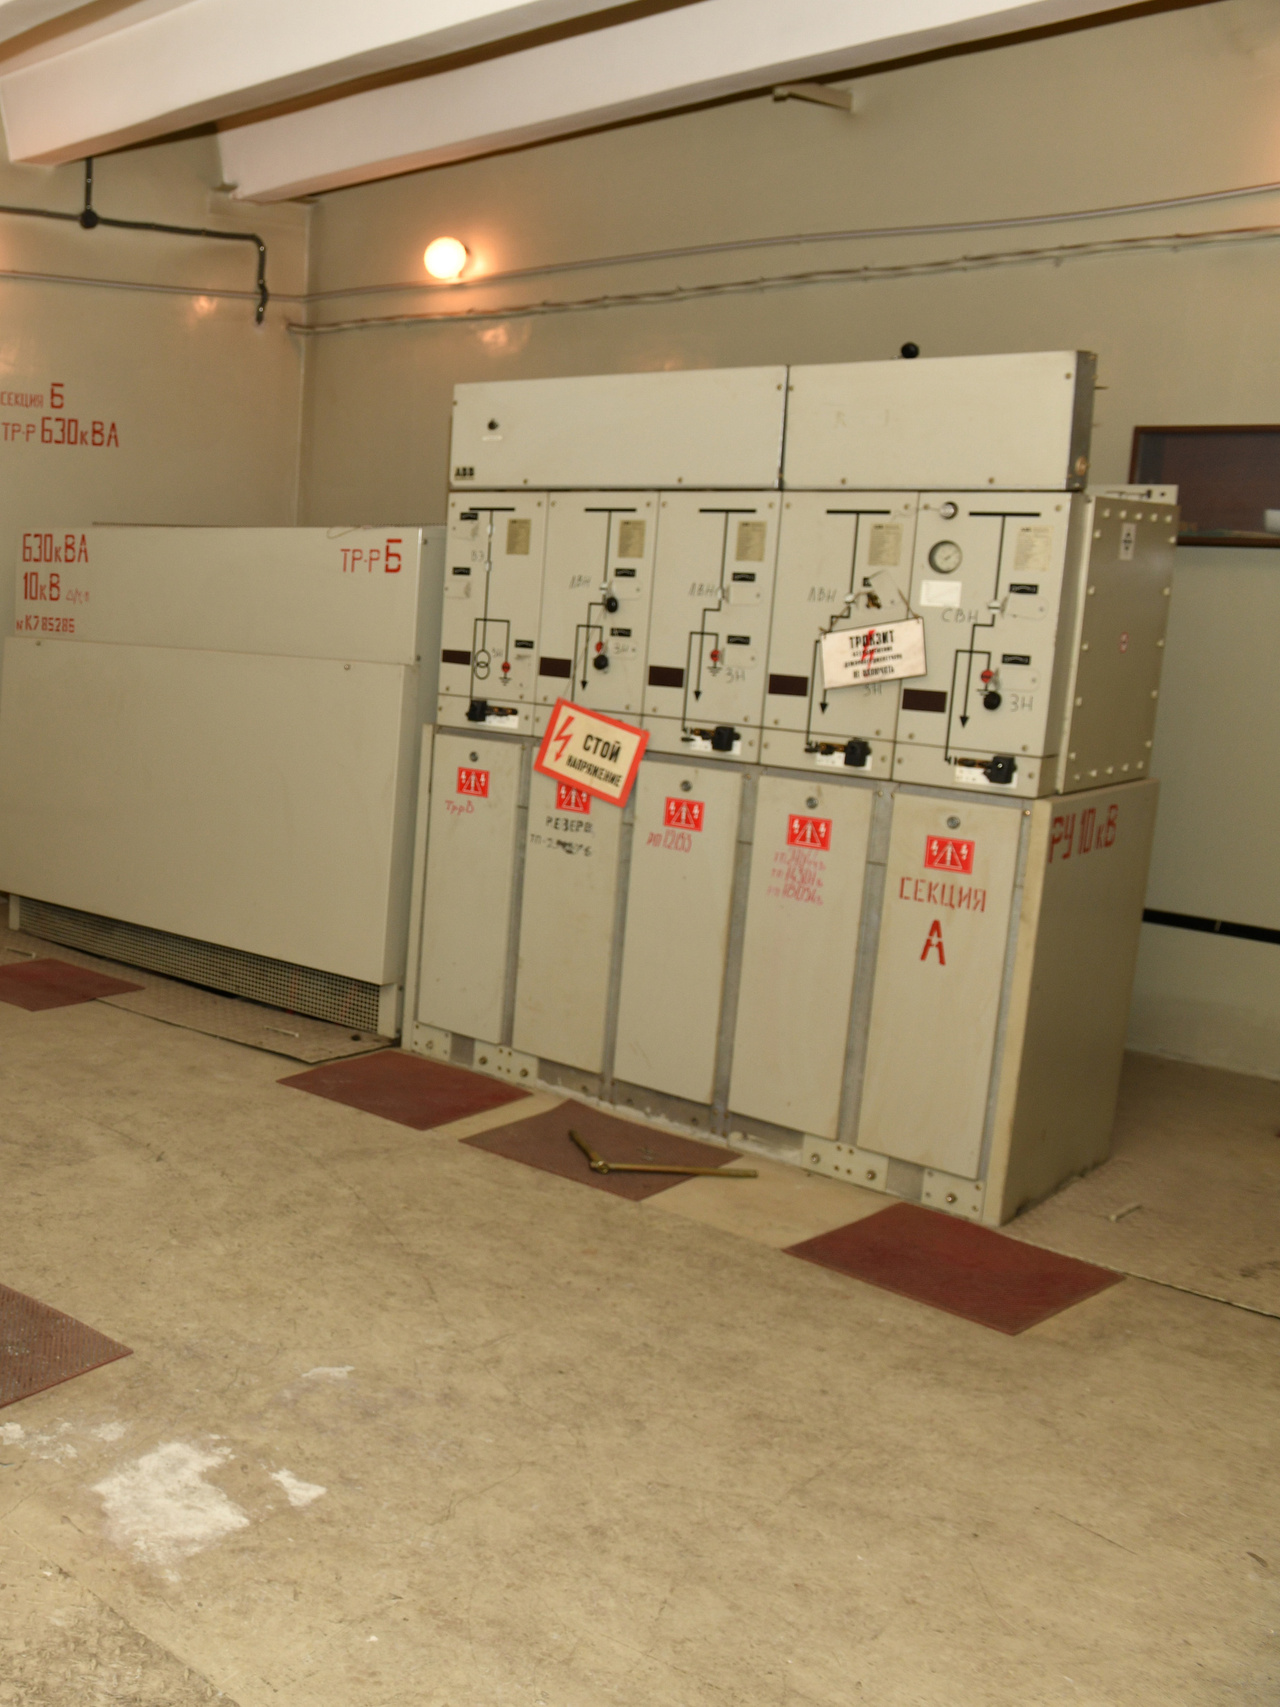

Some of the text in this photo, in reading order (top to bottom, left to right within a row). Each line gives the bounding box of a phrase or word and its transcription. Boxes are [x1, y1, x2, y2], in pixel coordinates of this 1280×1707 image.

[0, 383, 65, 409] СЕКЦИЯ Б
[454, 467, 474, 477] ABB
[22, 533, 88, 563] 630кВА
[384, 538, 402, 573] Б
[23, 571, 60, 601] 10кВ
[941, 608, 979, 623] СВН
[1010, 693, 1034, 713] ЗН
[583, 734, 622, 763] СТОЙ
[566, 755, 623, 788] НАПРЯЖЕНИЕ
[899, 876, 987, 912] СЕКЦИЯ
[920, 919, 946, 966] А
